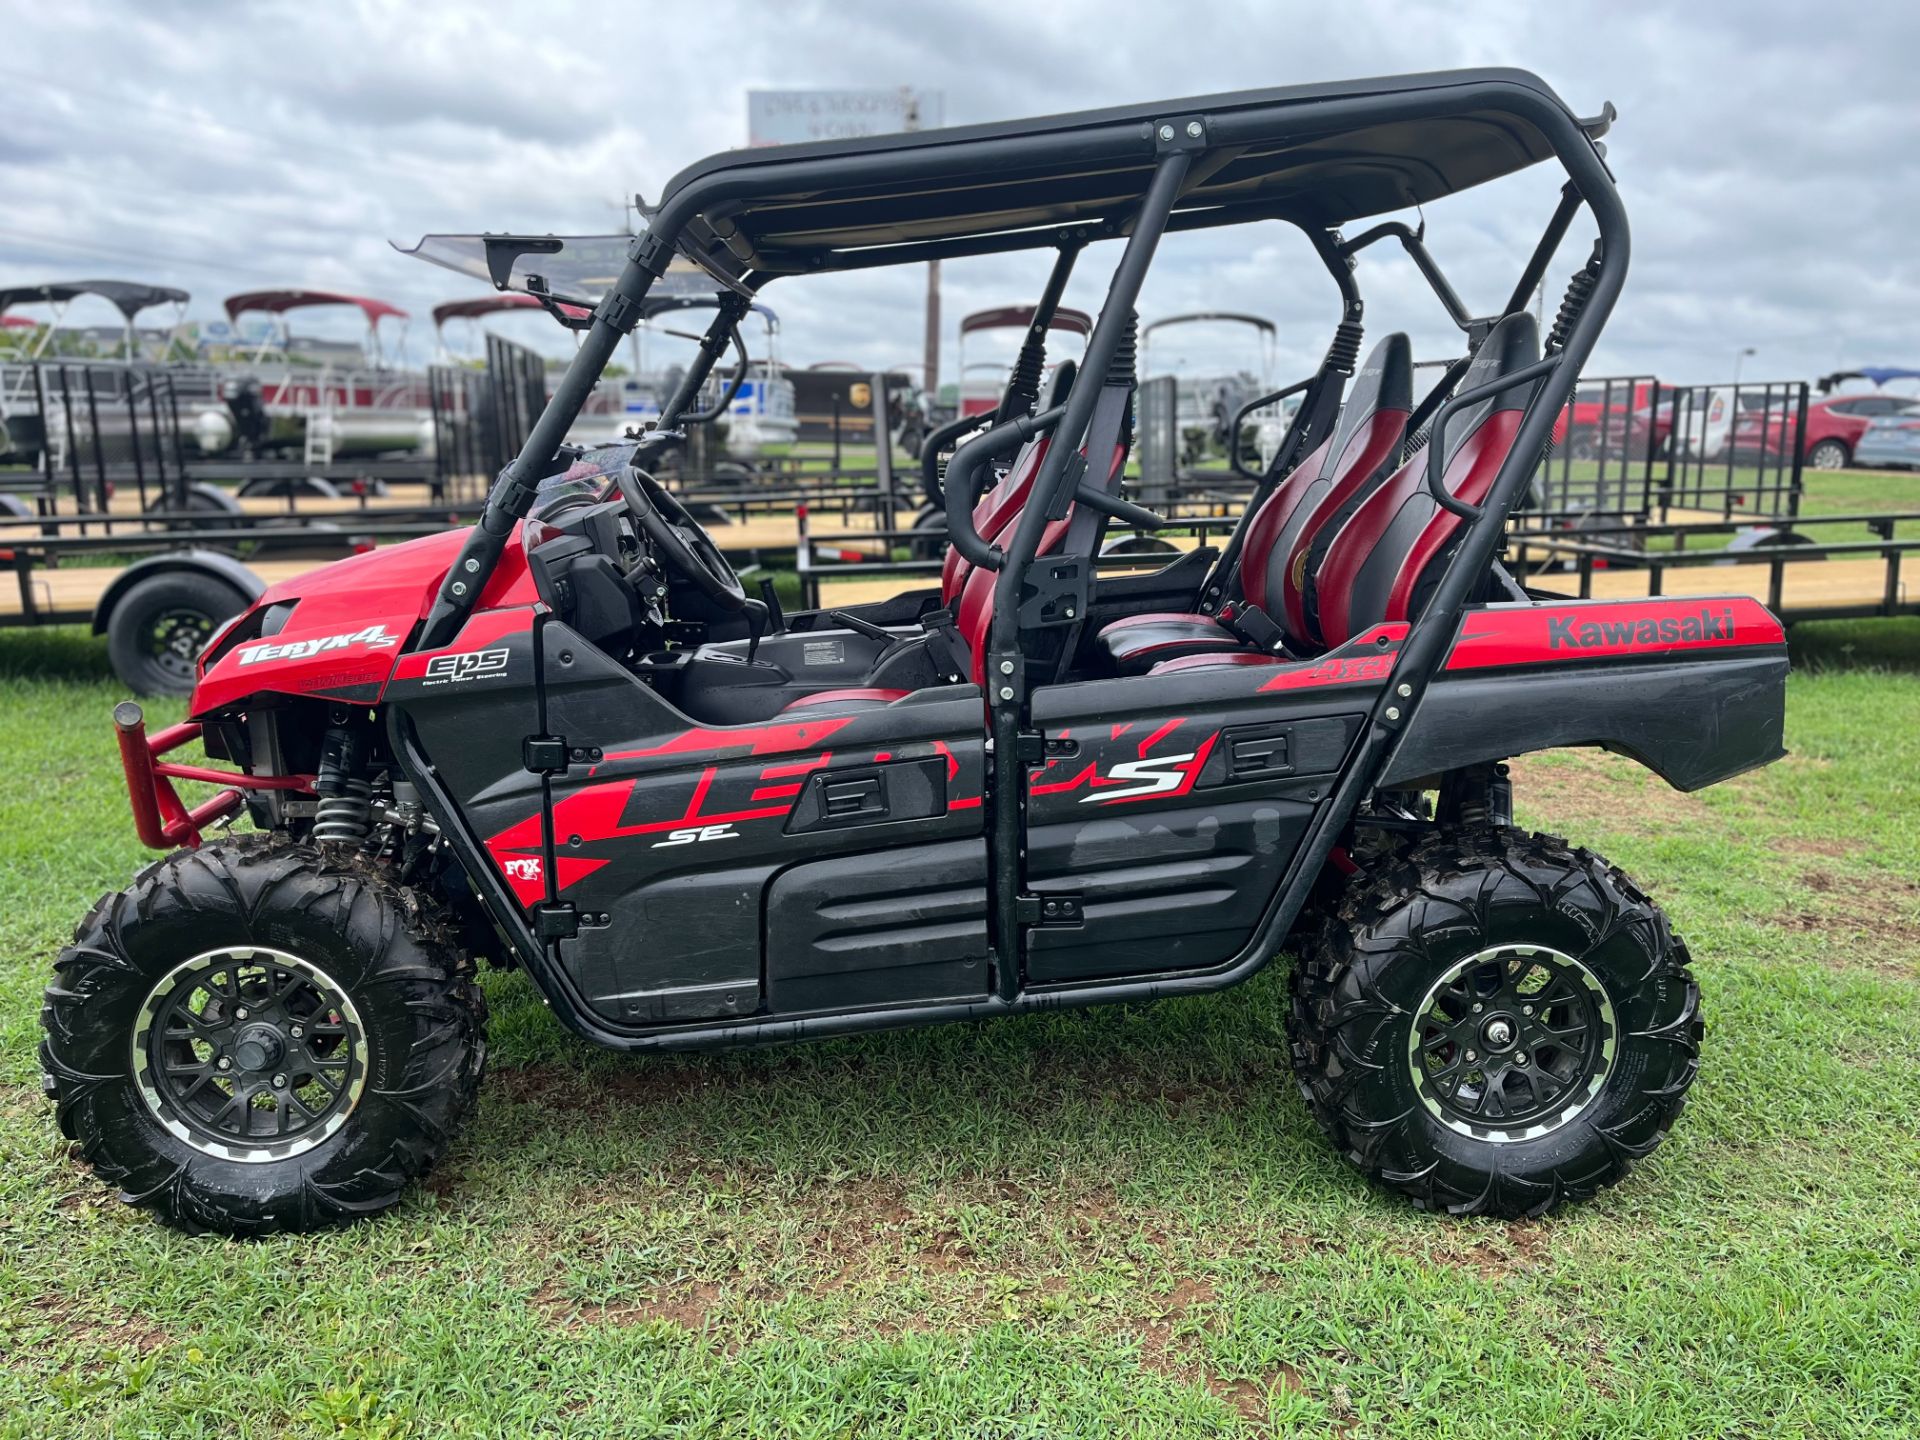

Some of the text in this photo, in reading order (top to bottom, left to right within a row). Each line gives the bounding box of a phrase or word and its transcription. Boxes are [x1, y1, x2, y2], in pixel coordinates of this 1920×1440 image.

[1547, 608, 1734, 649] Kawasaki
[425, 648, 510, 679] EPS
[650, 823, 741, 849] SE
[504, 858, 542, 881] FOX
